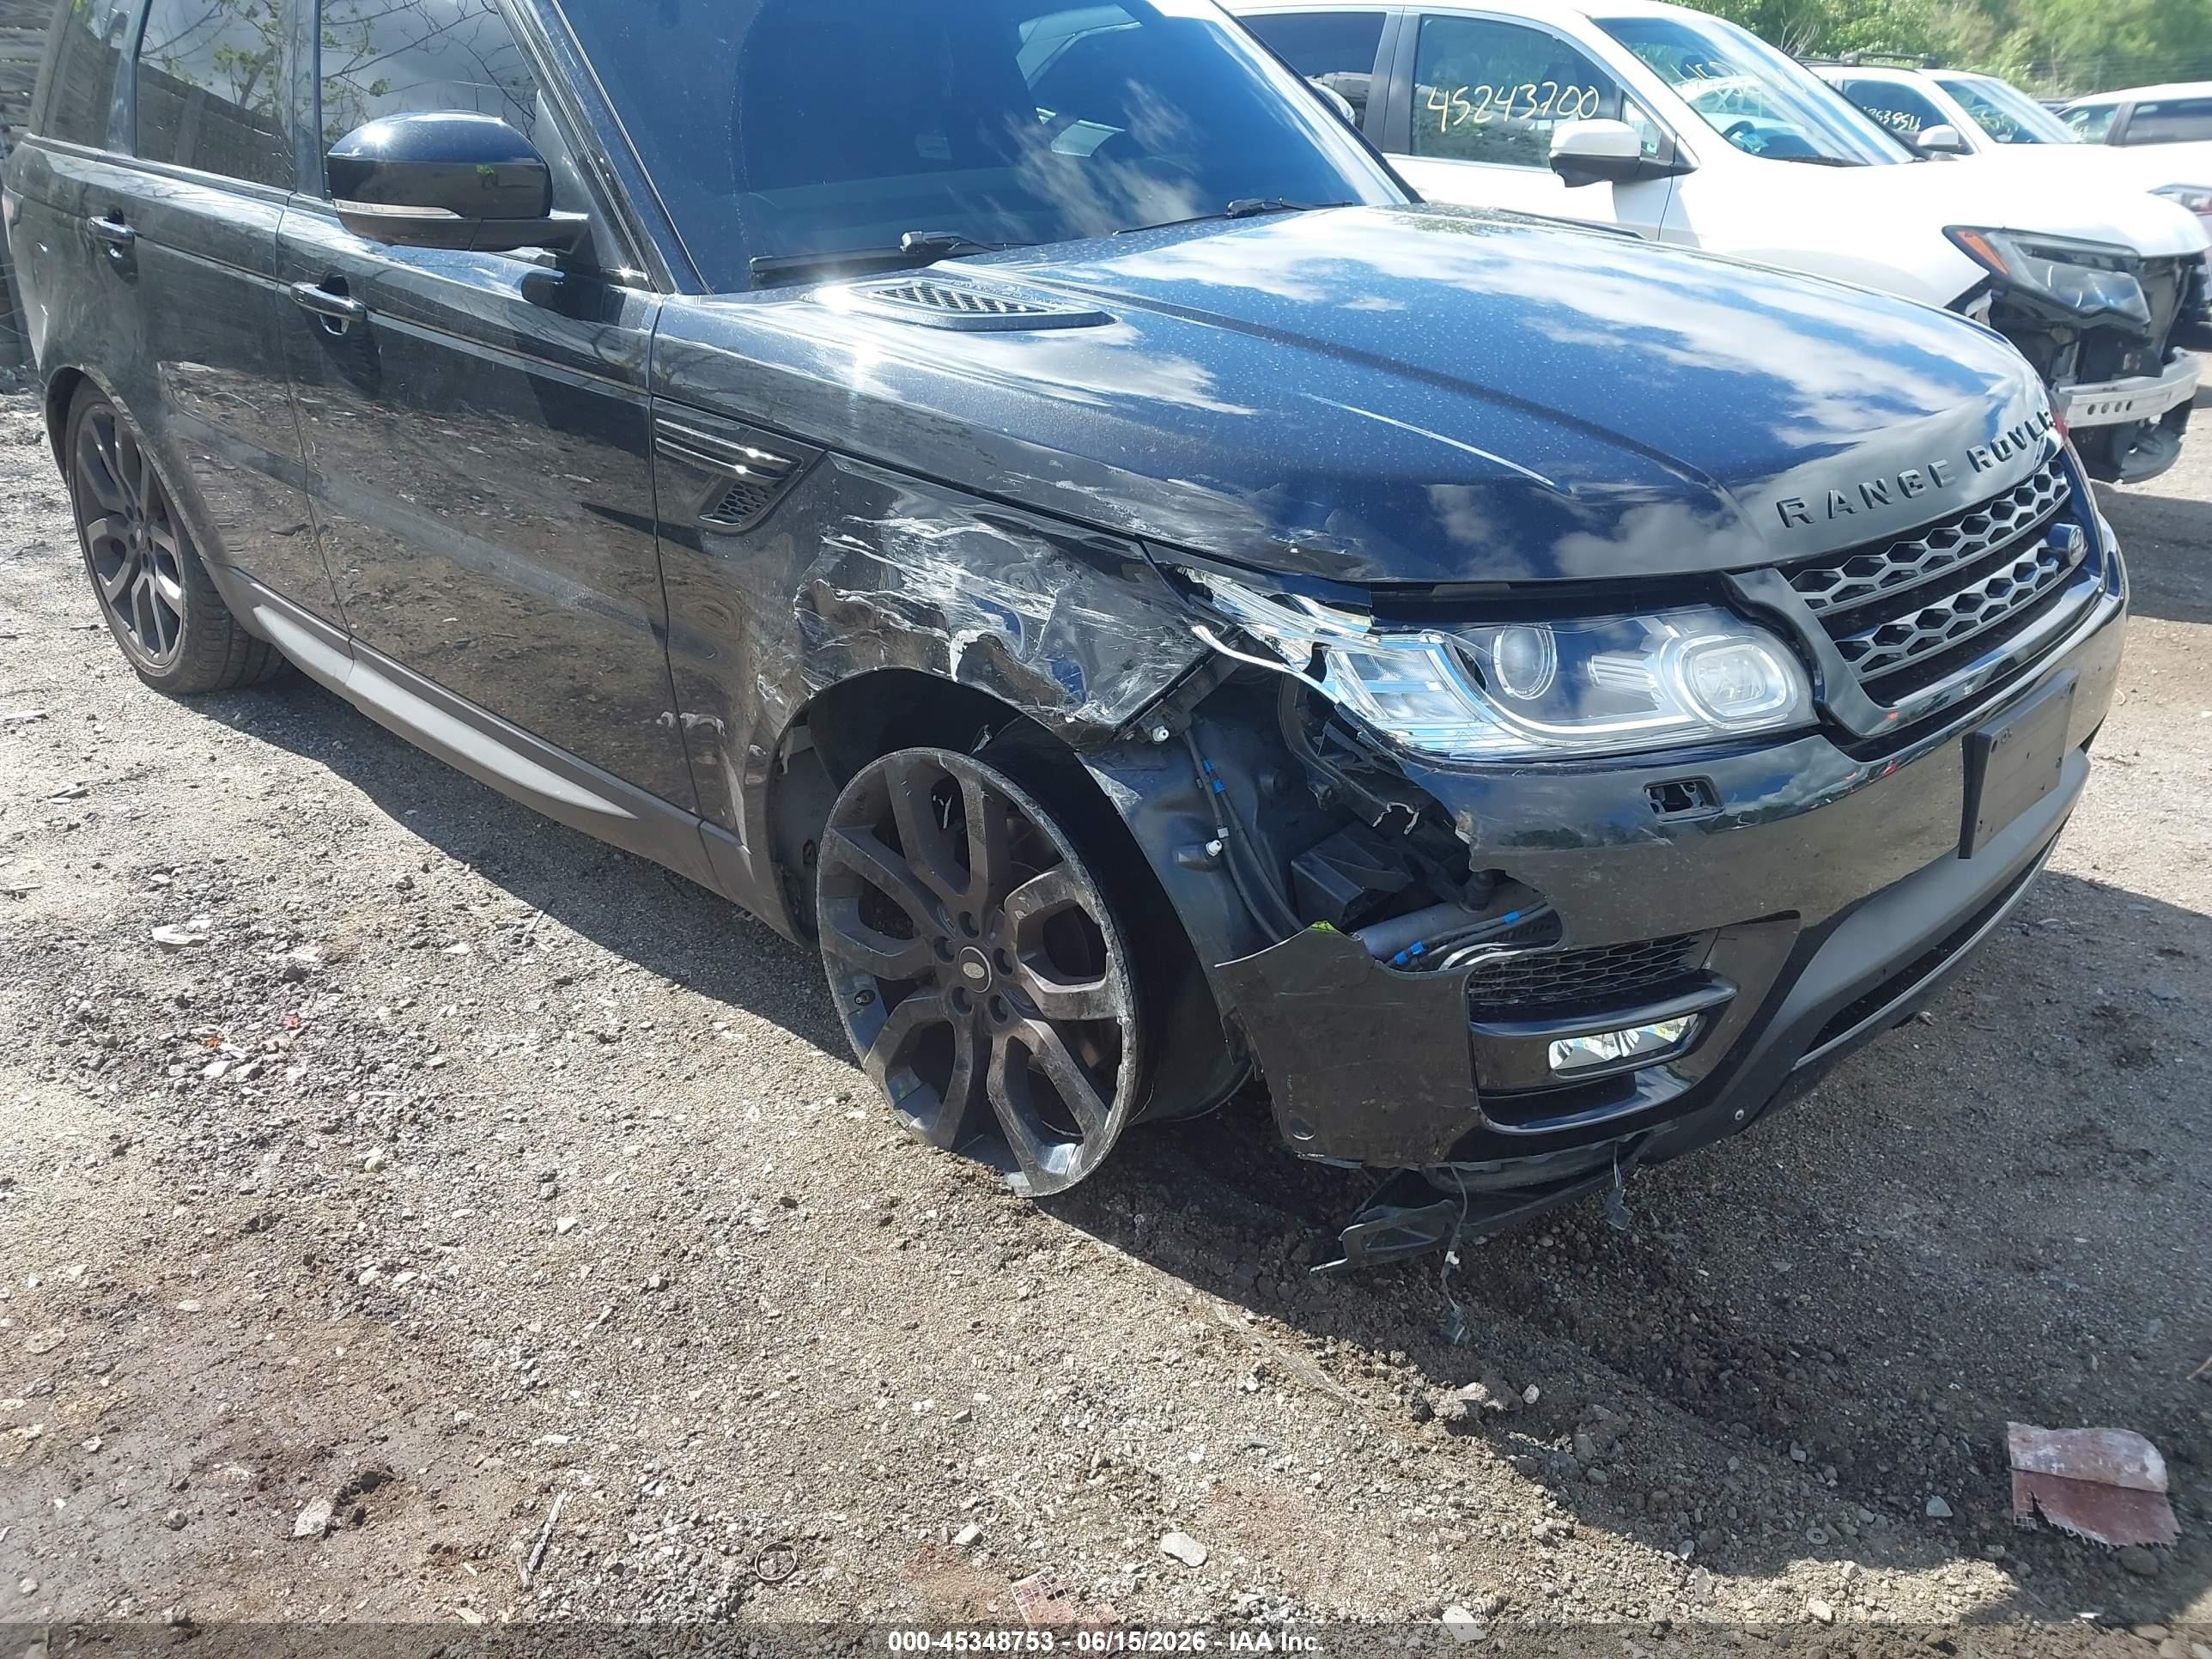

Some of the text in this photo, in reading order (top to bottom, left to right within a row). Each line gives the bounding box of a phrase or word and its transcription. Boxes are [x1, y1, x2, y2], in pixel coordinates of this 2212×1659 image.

[1427, 82, 1600, 132] 45243700
[1775, 410, 2057, 528] RANGE ROVER
